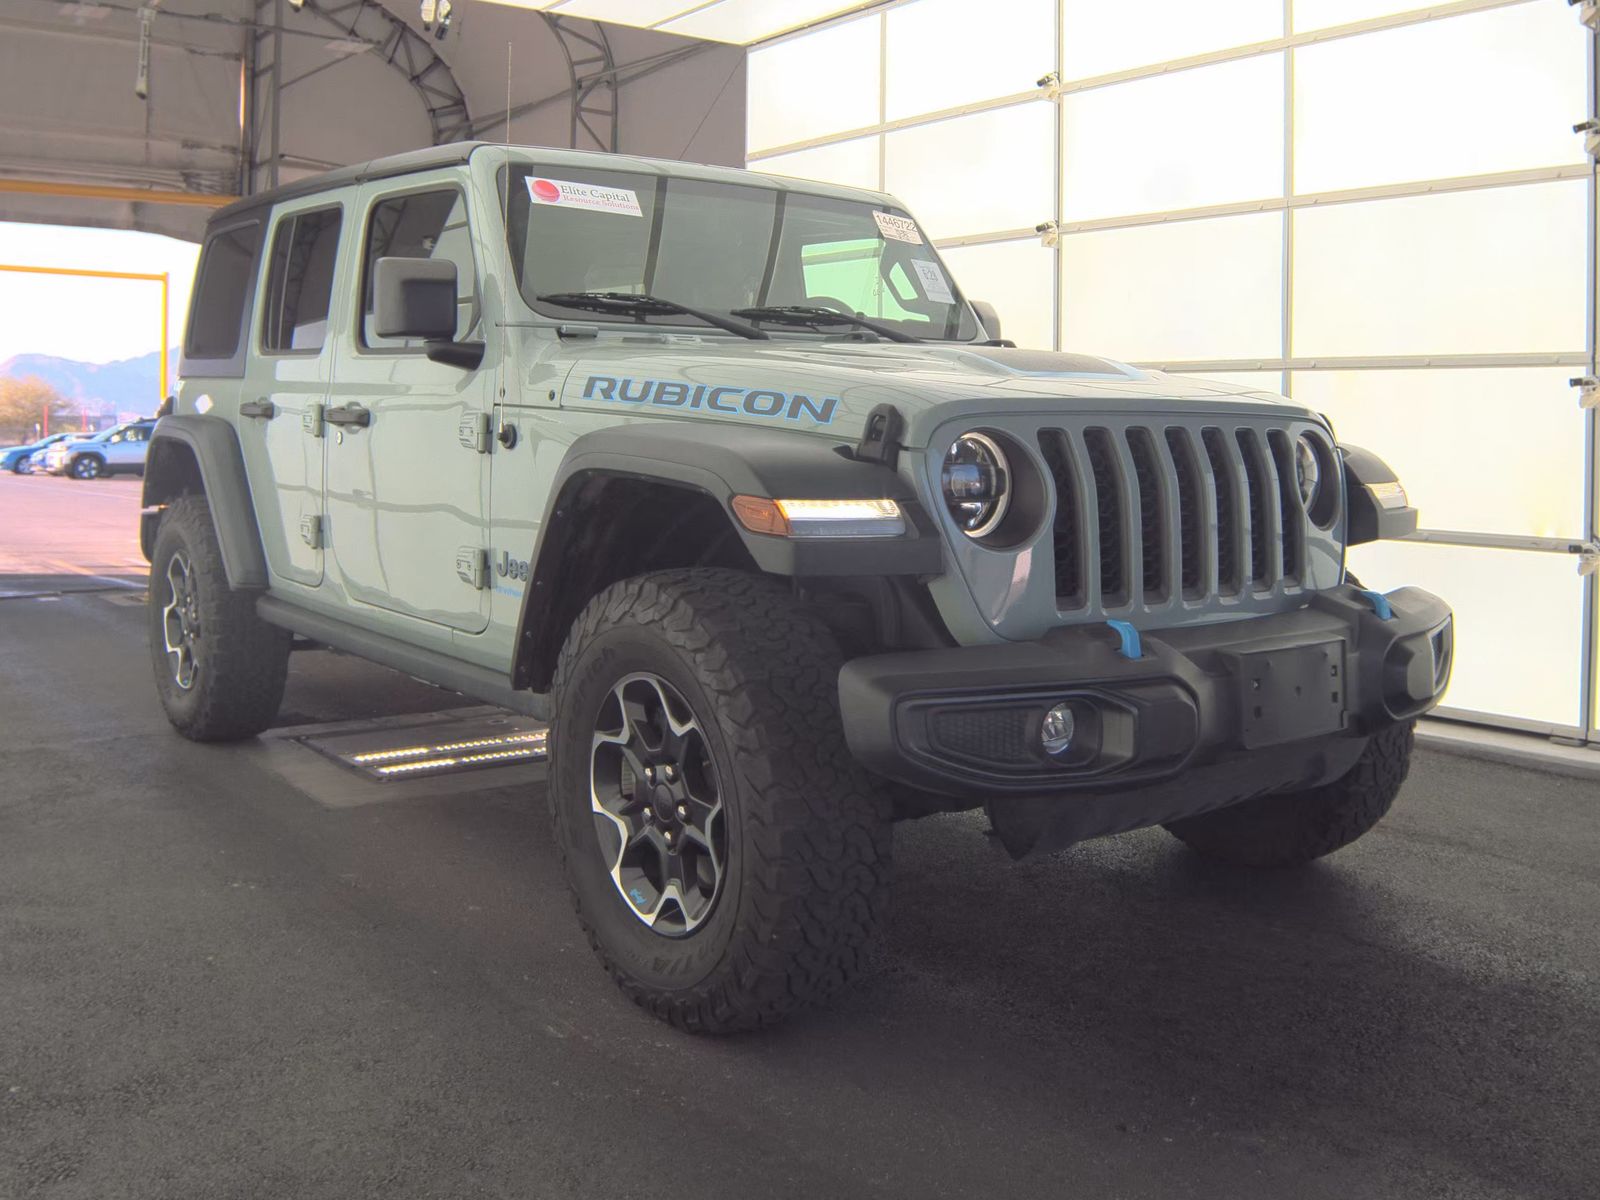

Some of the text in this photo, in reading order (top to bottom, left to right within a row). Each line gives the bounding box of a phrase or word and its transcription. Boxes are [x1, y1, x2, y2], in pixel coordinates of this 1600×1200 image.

[561, 184, 631, 203] Elite Capital
[601, 198, 641, 211] Solutions
[582, 375, 839, 425] RUBICON
[497, 550, 529, 582] Jee
